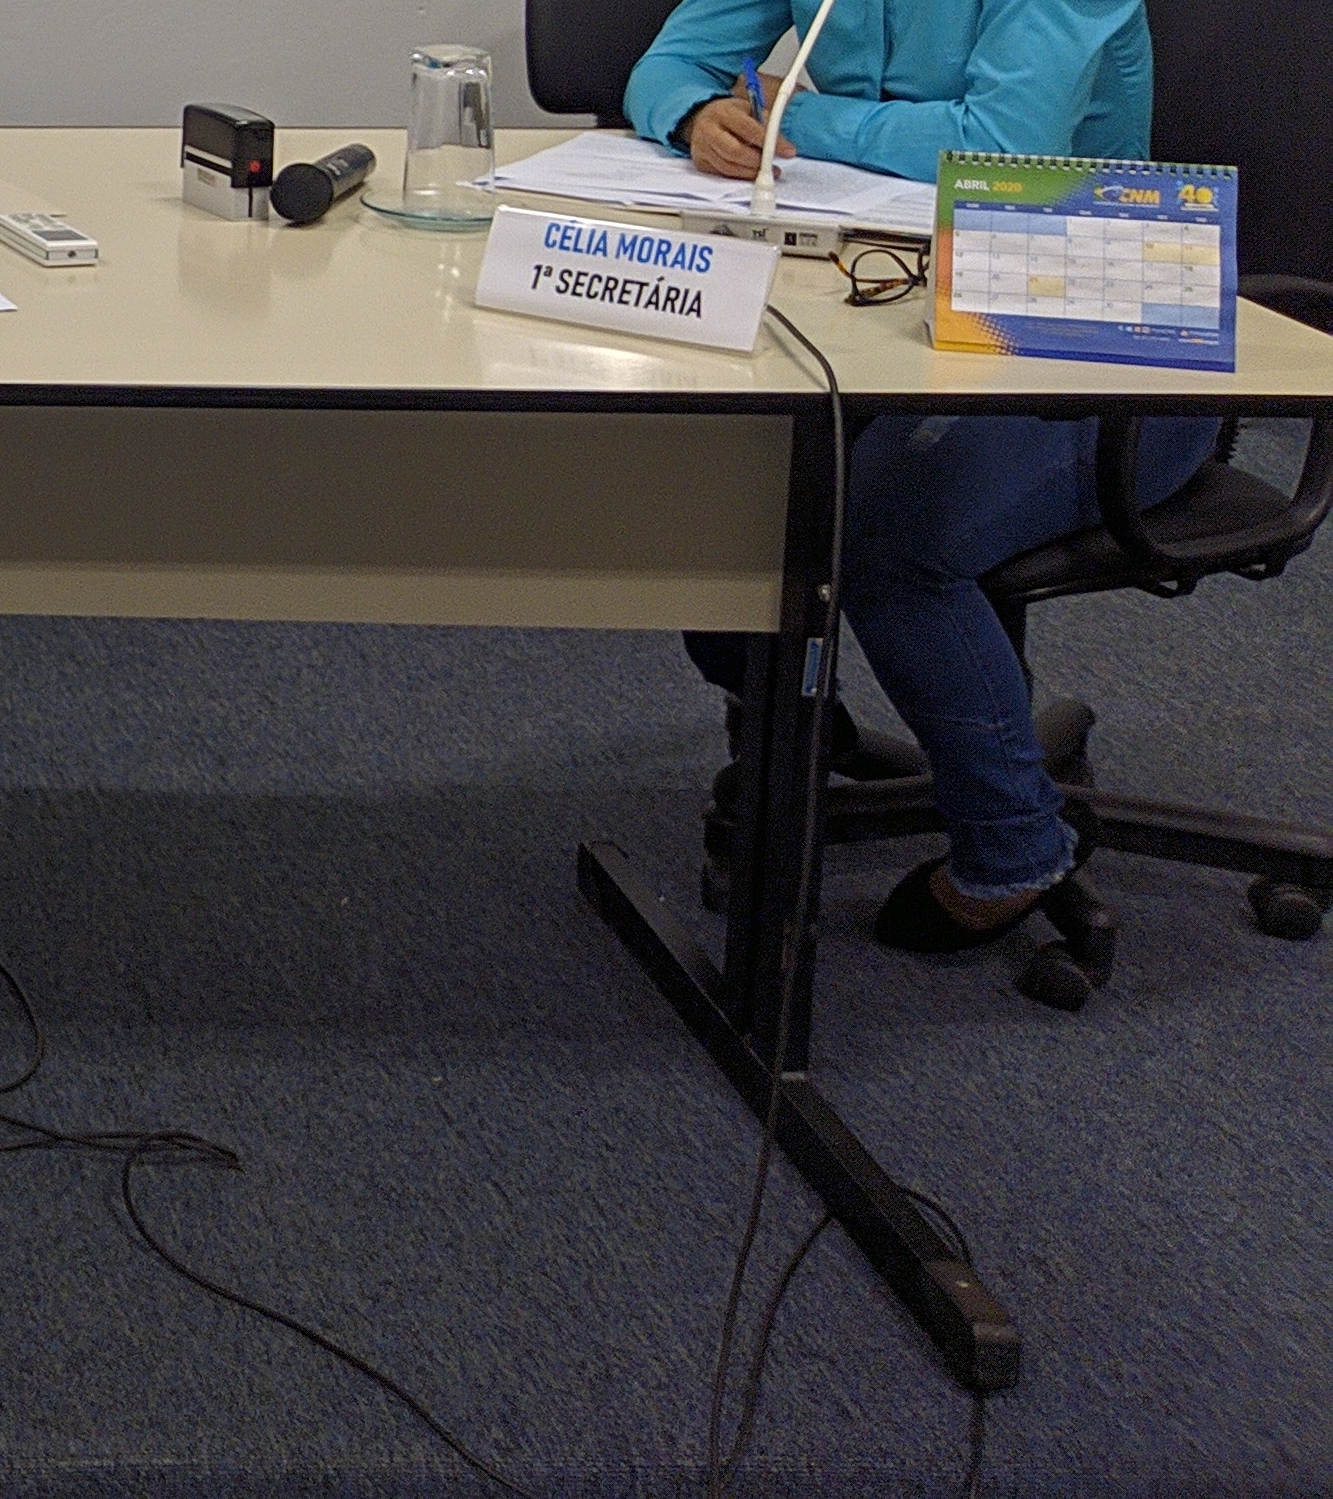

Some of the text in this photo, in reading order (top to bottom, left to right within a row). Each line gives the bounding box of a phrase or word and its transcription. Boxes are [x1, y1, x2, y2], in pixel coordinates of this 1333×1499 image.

[954, 179, 1024, 193] ABRIL 2020
[543, 219, 714, 274] CÉLIA MORAIS
[555, 268, 703, 319] SECRETÁRIA
